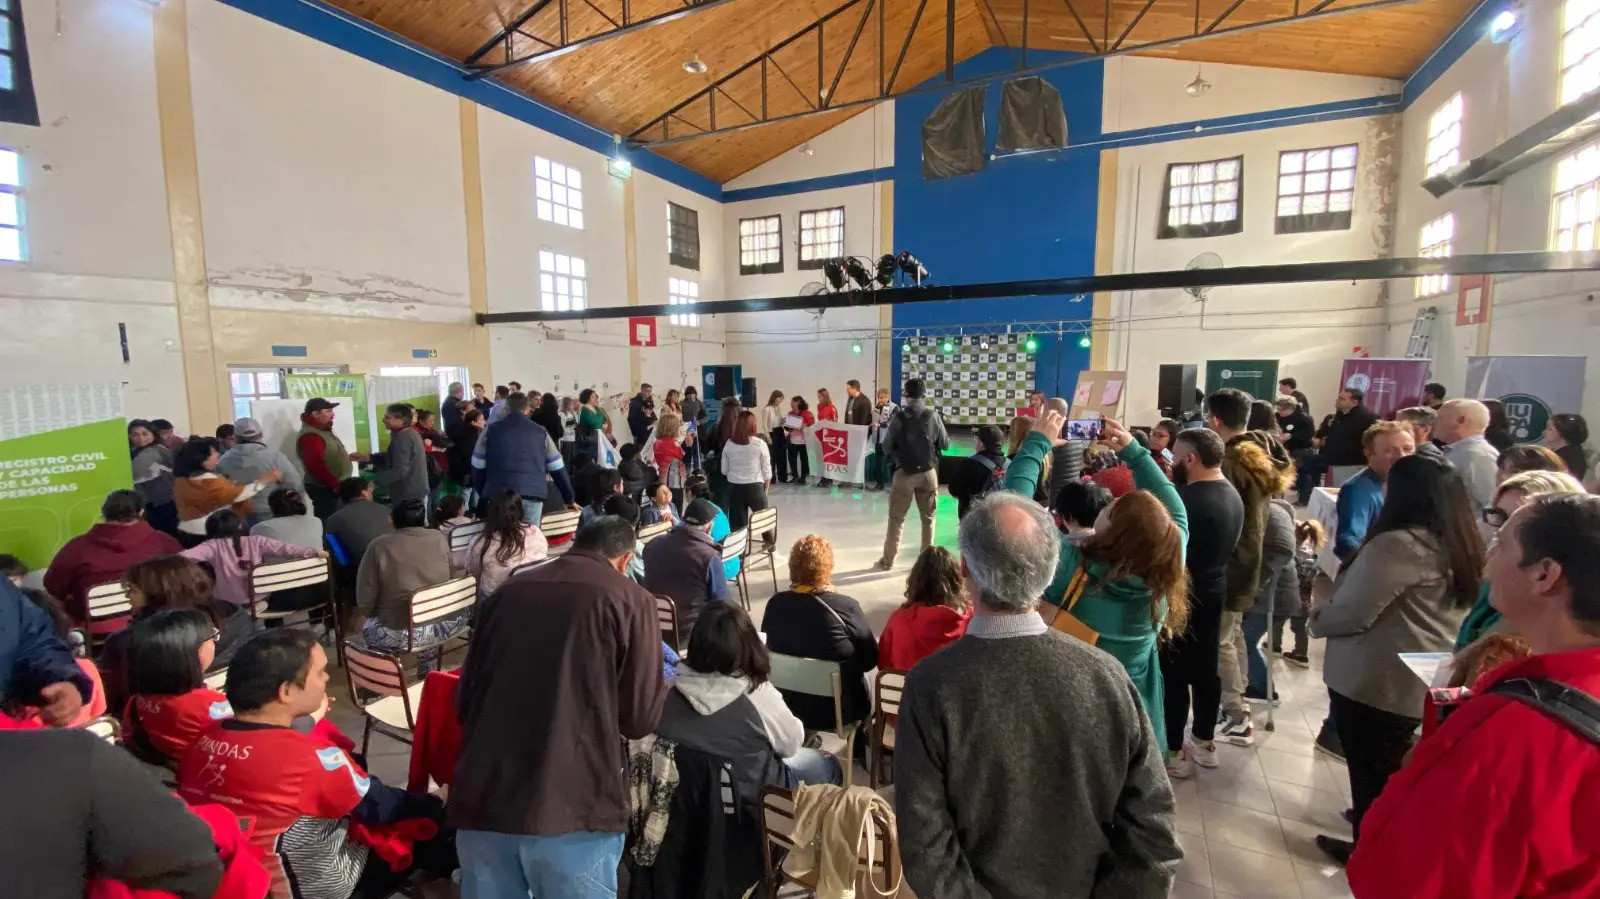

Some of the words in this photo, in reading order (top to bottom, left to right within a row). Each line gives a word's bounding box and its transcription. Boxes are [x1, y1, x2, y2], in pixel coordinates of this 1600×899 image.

[71, 452, 108, 462] CIVIL
[9, 462, 97, 478] CAPACIDAD
[826, 463, 848, 473] DAS
[0, 480, 17, 490] DE
[22, 476, 50, 487] LAS
[0, 482, 78, 499] PERSONAS
